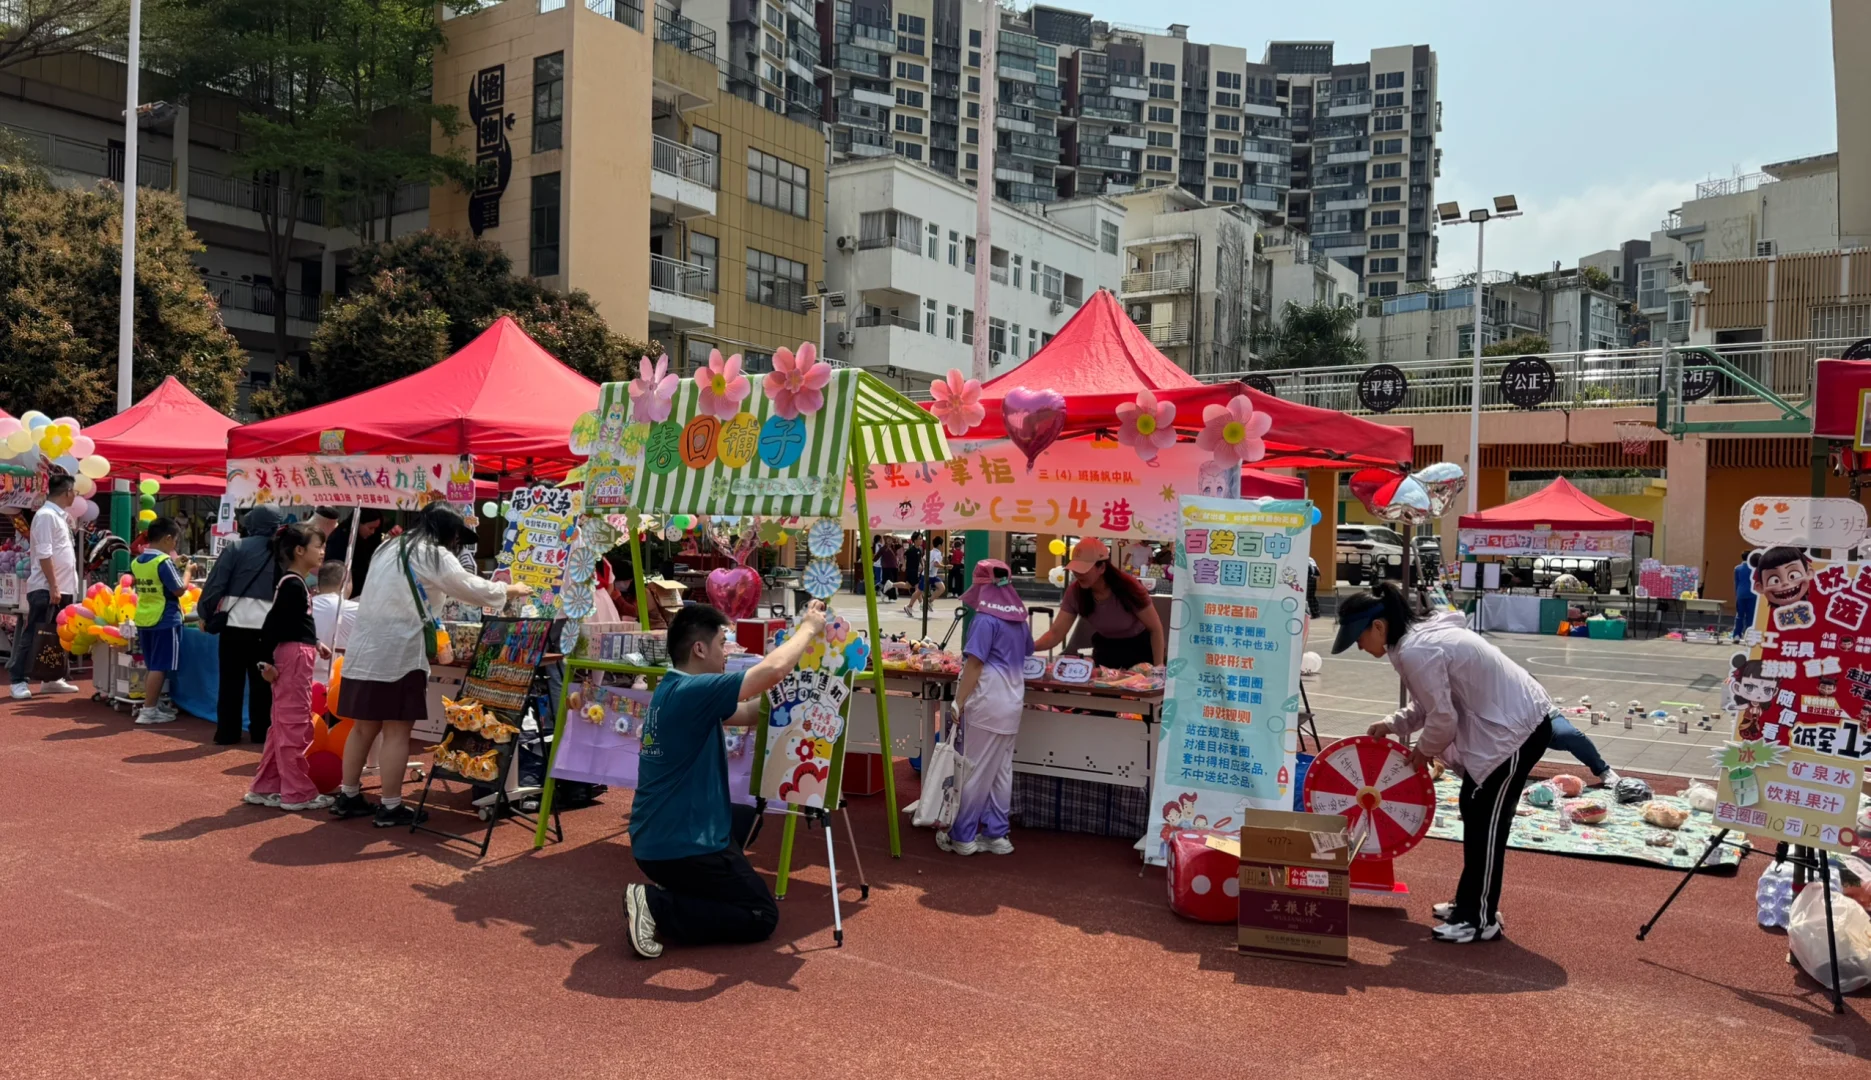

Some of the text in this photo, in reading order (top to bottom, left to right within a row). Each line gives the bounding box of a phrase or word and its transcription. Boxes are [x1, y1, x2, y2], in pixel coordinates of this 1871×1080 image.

[1369, 379, 1394, 396] 平等
[1514, 373, 1541, 390] 公正
[1184, 528, 1292, 560] 百发百中
[1193, 557, 1278, 589] 套圈圈
[1204, 602, 1259, 619] 游戏名称
[1198, 622, 1266, 638] 百发百中套圈圈
[1745, 630, 1780, 649] 手工
[1780, 640, 1815, 658] 玩具
[1205, 653, 1255, 670] 游戏形式
[1203, 705, 1251, 724] 游戏规则
[1738, 747, 1756, 763] 冰
[1791, 761, 1851, 785] 矿泉水
[1767, 785, 1840, 812] 饮料果汁
[1264, 899, 1322, 918] 五粮液
